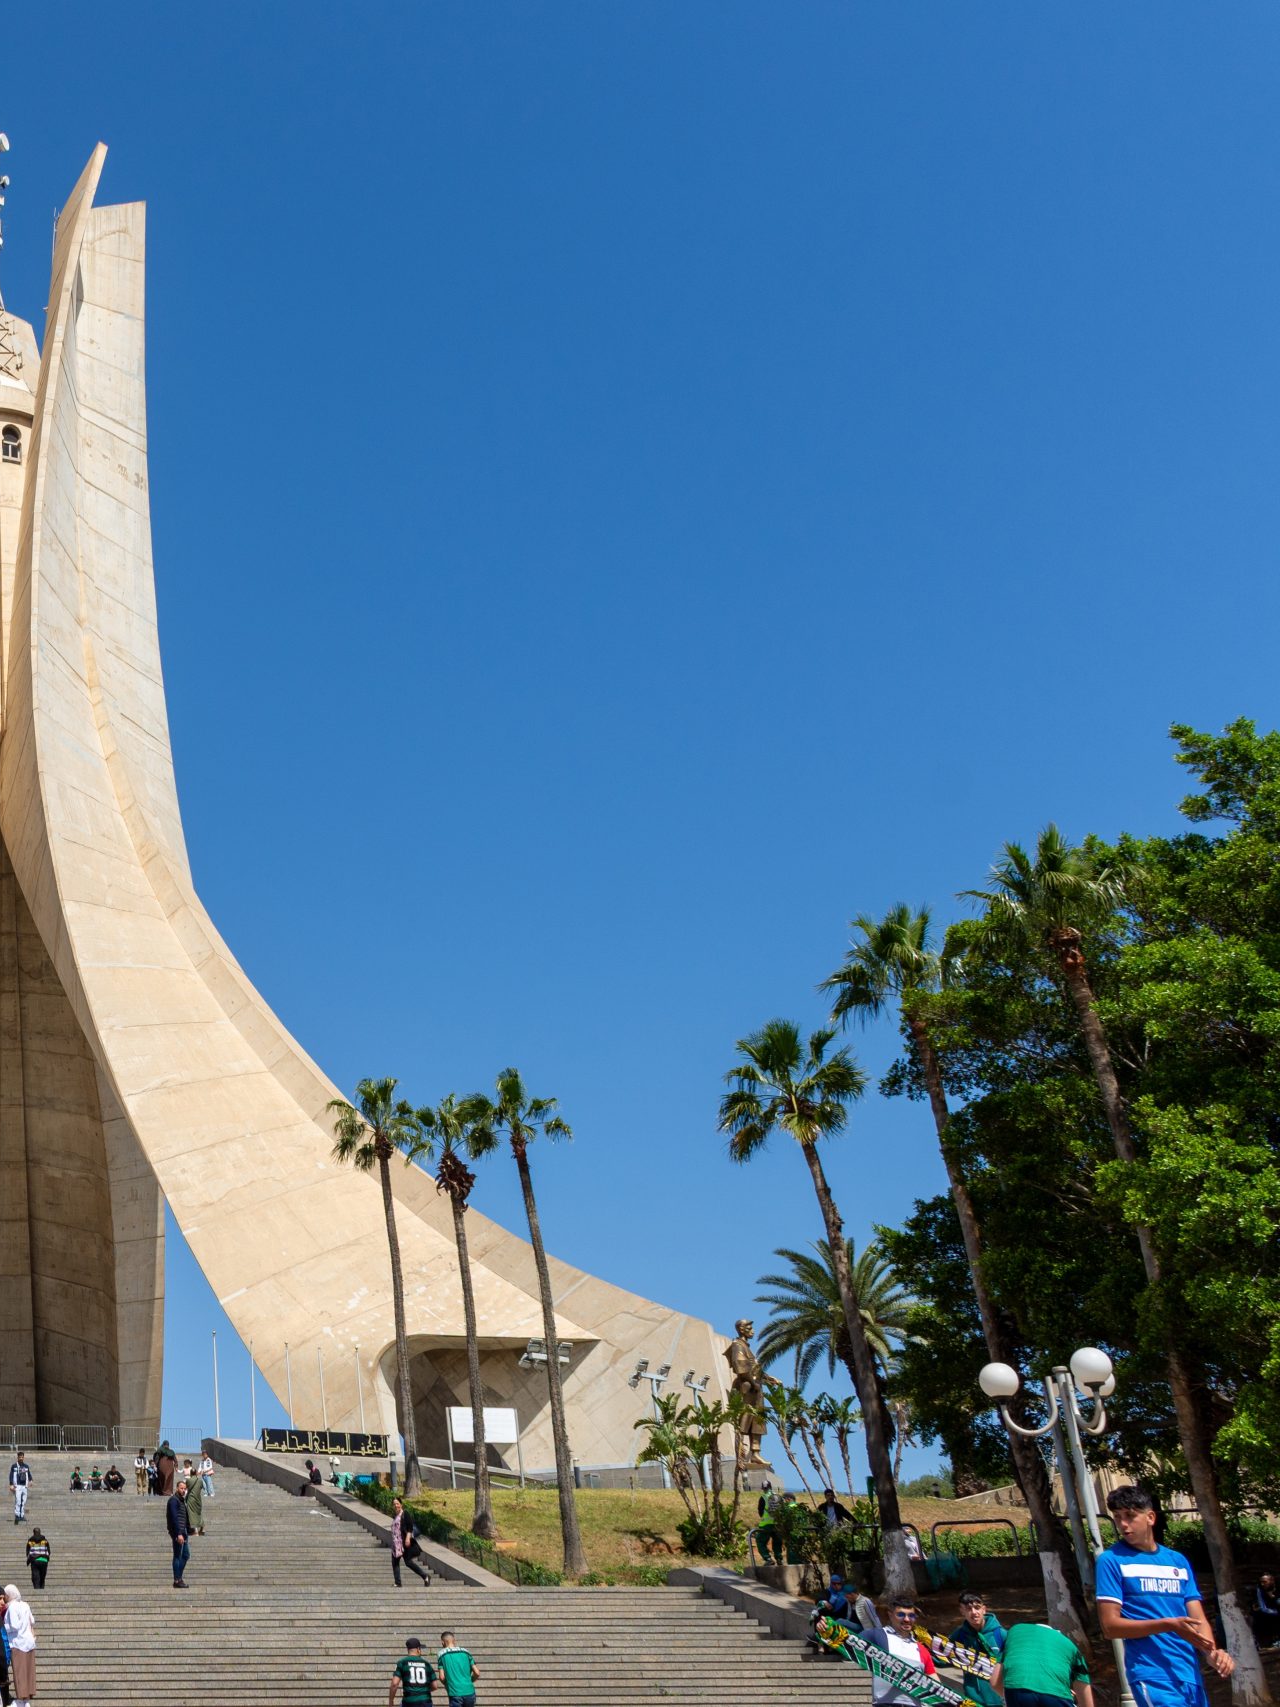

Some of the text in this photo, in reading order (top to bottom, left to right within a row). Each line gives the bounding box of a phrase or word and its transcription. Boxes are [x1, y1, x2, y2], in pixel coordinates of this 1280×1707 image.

[409, 1667, 427, 1684] 10
[846, 1634, 962, 1706] CS CONSTANTINE
